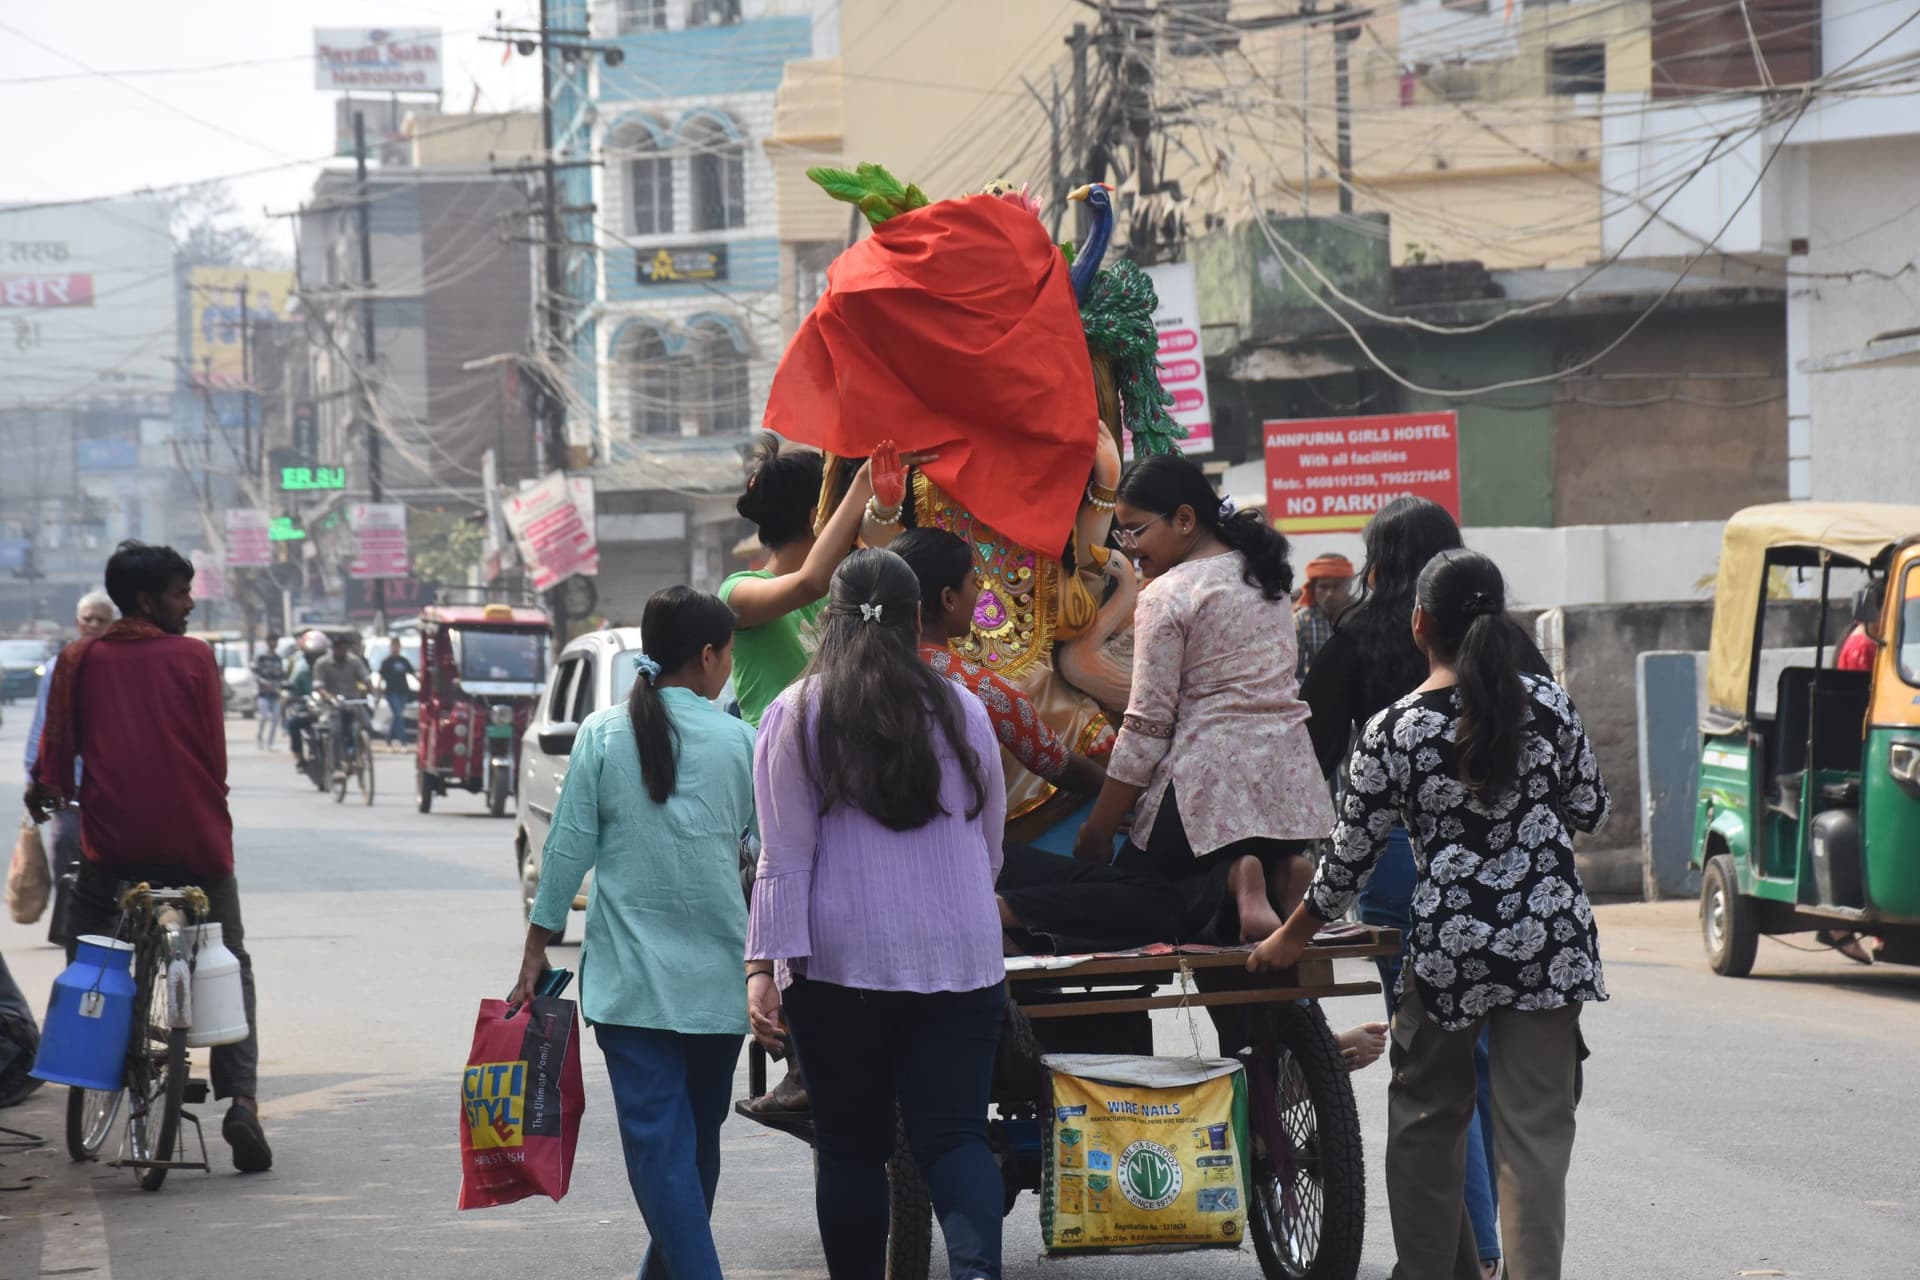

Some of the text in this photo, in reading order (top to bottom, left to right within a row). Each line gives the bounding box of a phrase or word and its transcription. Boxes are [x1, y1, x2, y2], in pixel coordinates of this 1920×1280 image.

[1266, 424, 1450, 448] ANNPURNA GIRLS HOSTEL
[1299, 449, 1408, 468] With all facilities
[1287, 497, 1316, 515] NO
[537, 1042, 553, 1072] Family
[463, 1064, 524, 1100] CITI
[534, 1072, 547, 1109] Ultimate
[1107, 1100, 1181, 1117] WIRE NAILS
[532, 1109, 544, 1129] The
[1131, 1195, 1155, 1209] SINCE
[1114, 1222, 1148, 1231] Registration
